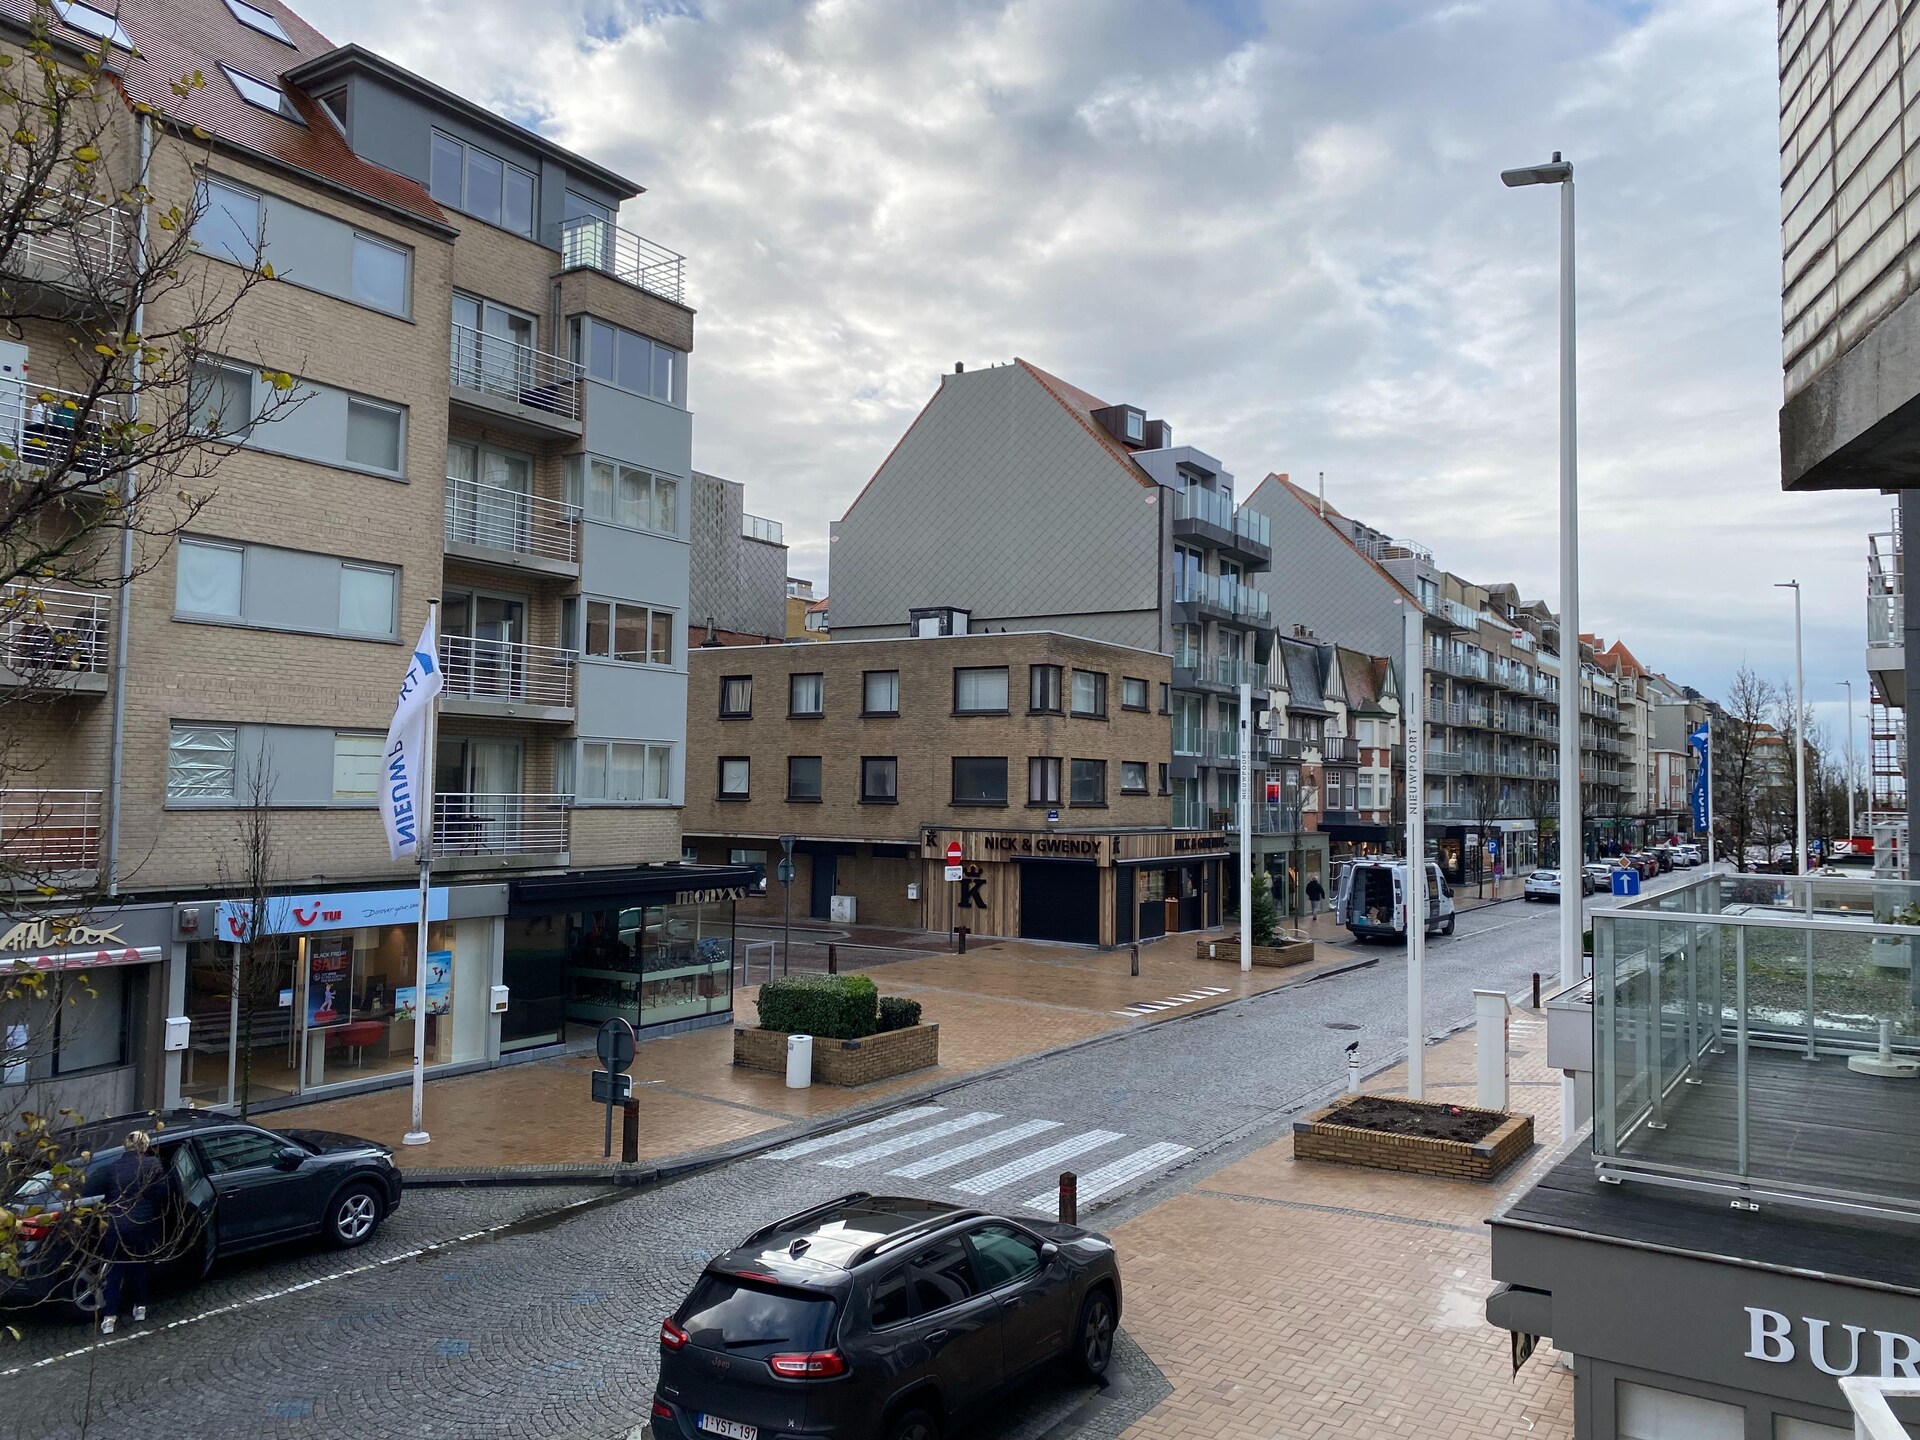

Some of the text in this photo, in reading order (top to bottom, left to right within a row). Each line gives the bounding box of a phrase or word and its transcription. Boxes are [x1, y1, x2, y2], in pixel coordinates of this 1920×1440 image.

[1408, 729, 1418, 815] NIEUWPOORT
[984, 836, 1103, 855] NICK & GWENDY
[675, 885, 747, 906] monyxs
[957, 878, 988, 909] K
[321, 909, 342, 922] TUI
[312, 956, 347, 972] SALE
[313, 951, 330, 959] BLACK
